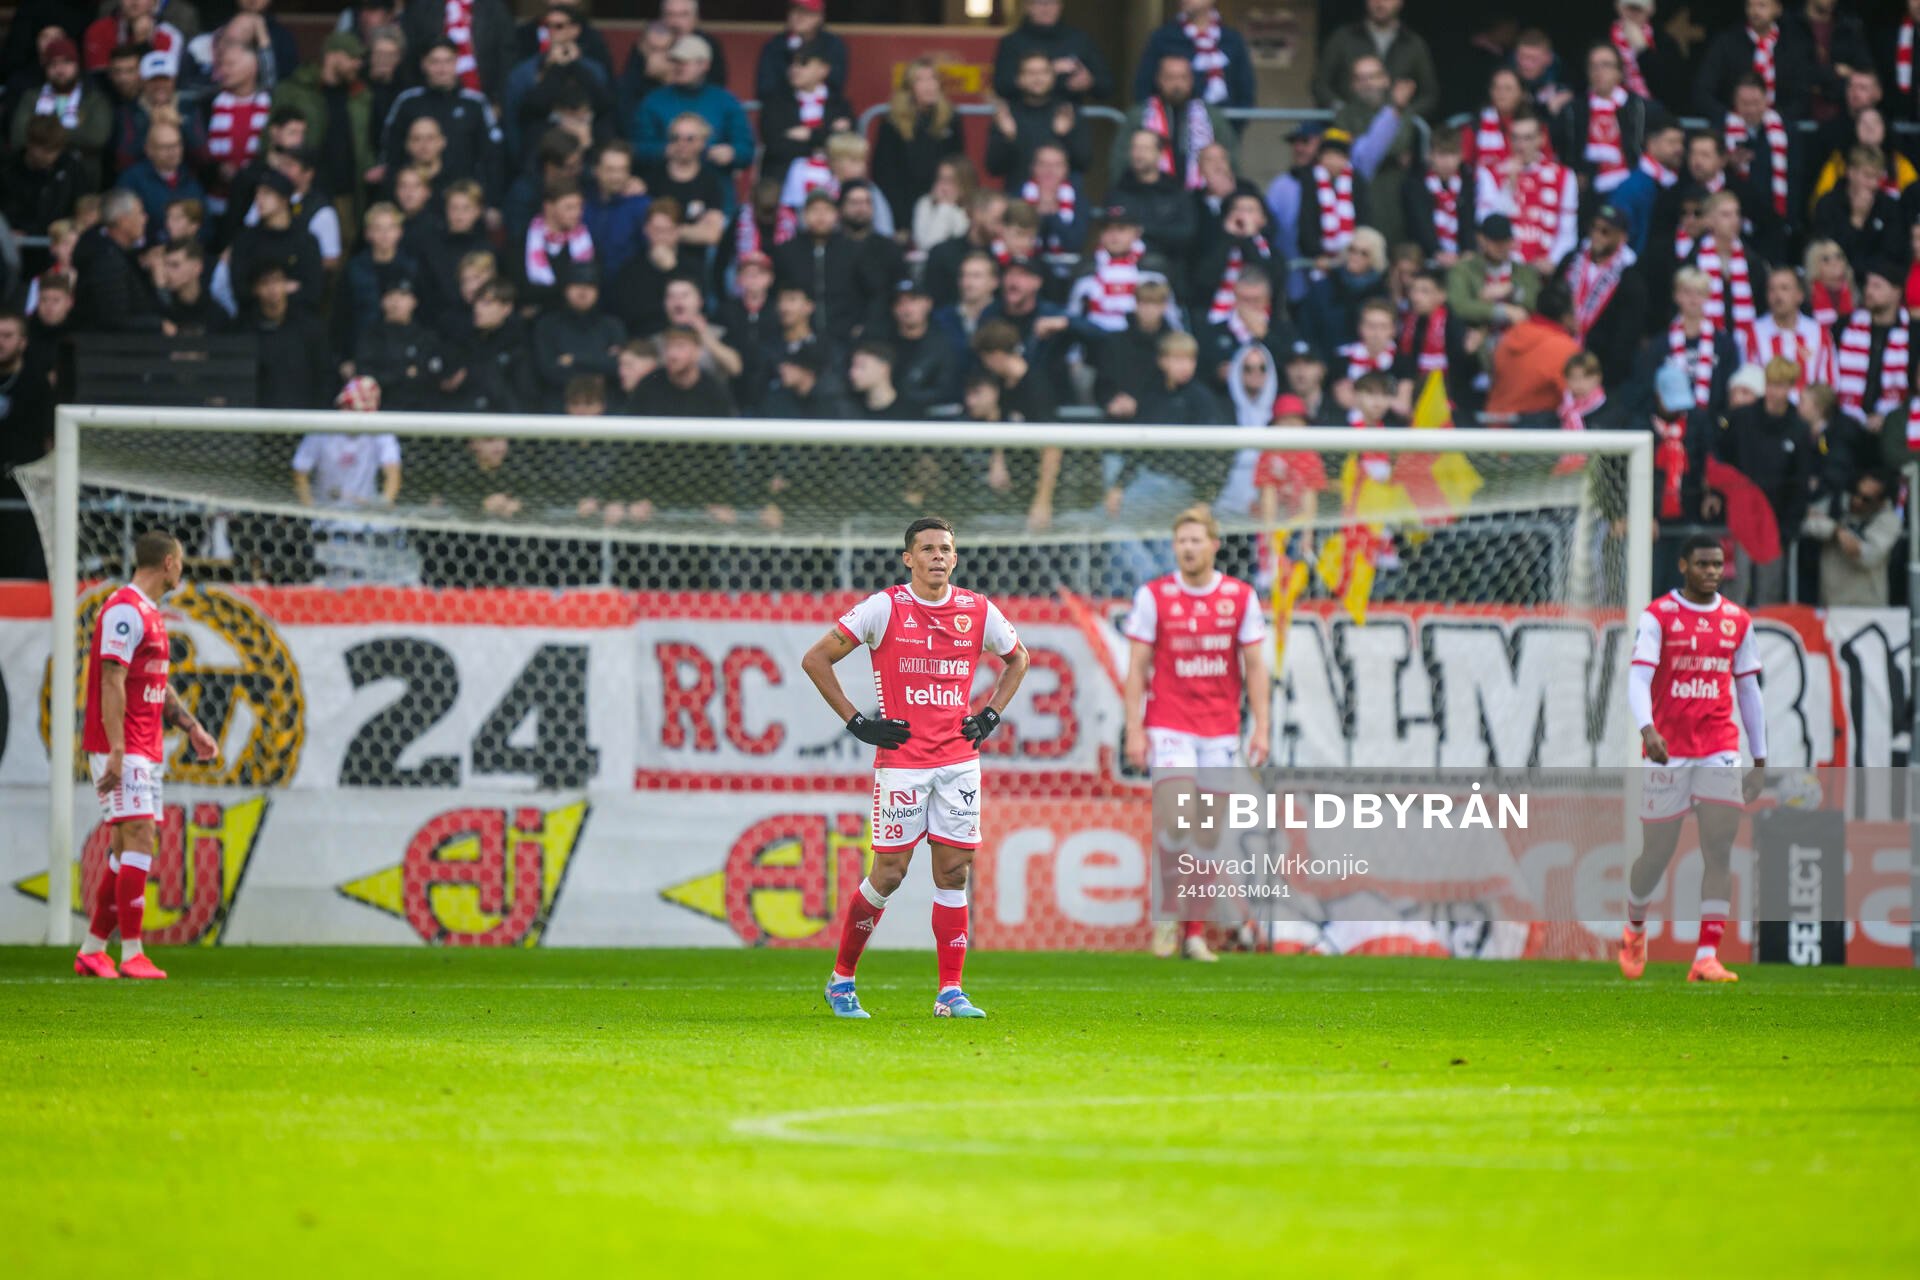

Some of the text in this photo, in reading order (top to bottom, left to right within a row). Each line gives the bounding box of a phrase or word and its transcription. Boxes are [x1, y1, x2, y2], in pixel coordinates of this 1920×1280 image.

[899, 658, 970, 675] MULTIBYGG
[654, 642, 786, 756] RC
[905, 684, 965, 706] telink
[338, 637, 598, 788] 24
[882, 804, 923, 822] Nybloms
[885, 824, 903, 839] 29
[1789, 844, 1822, 967] SELECT
